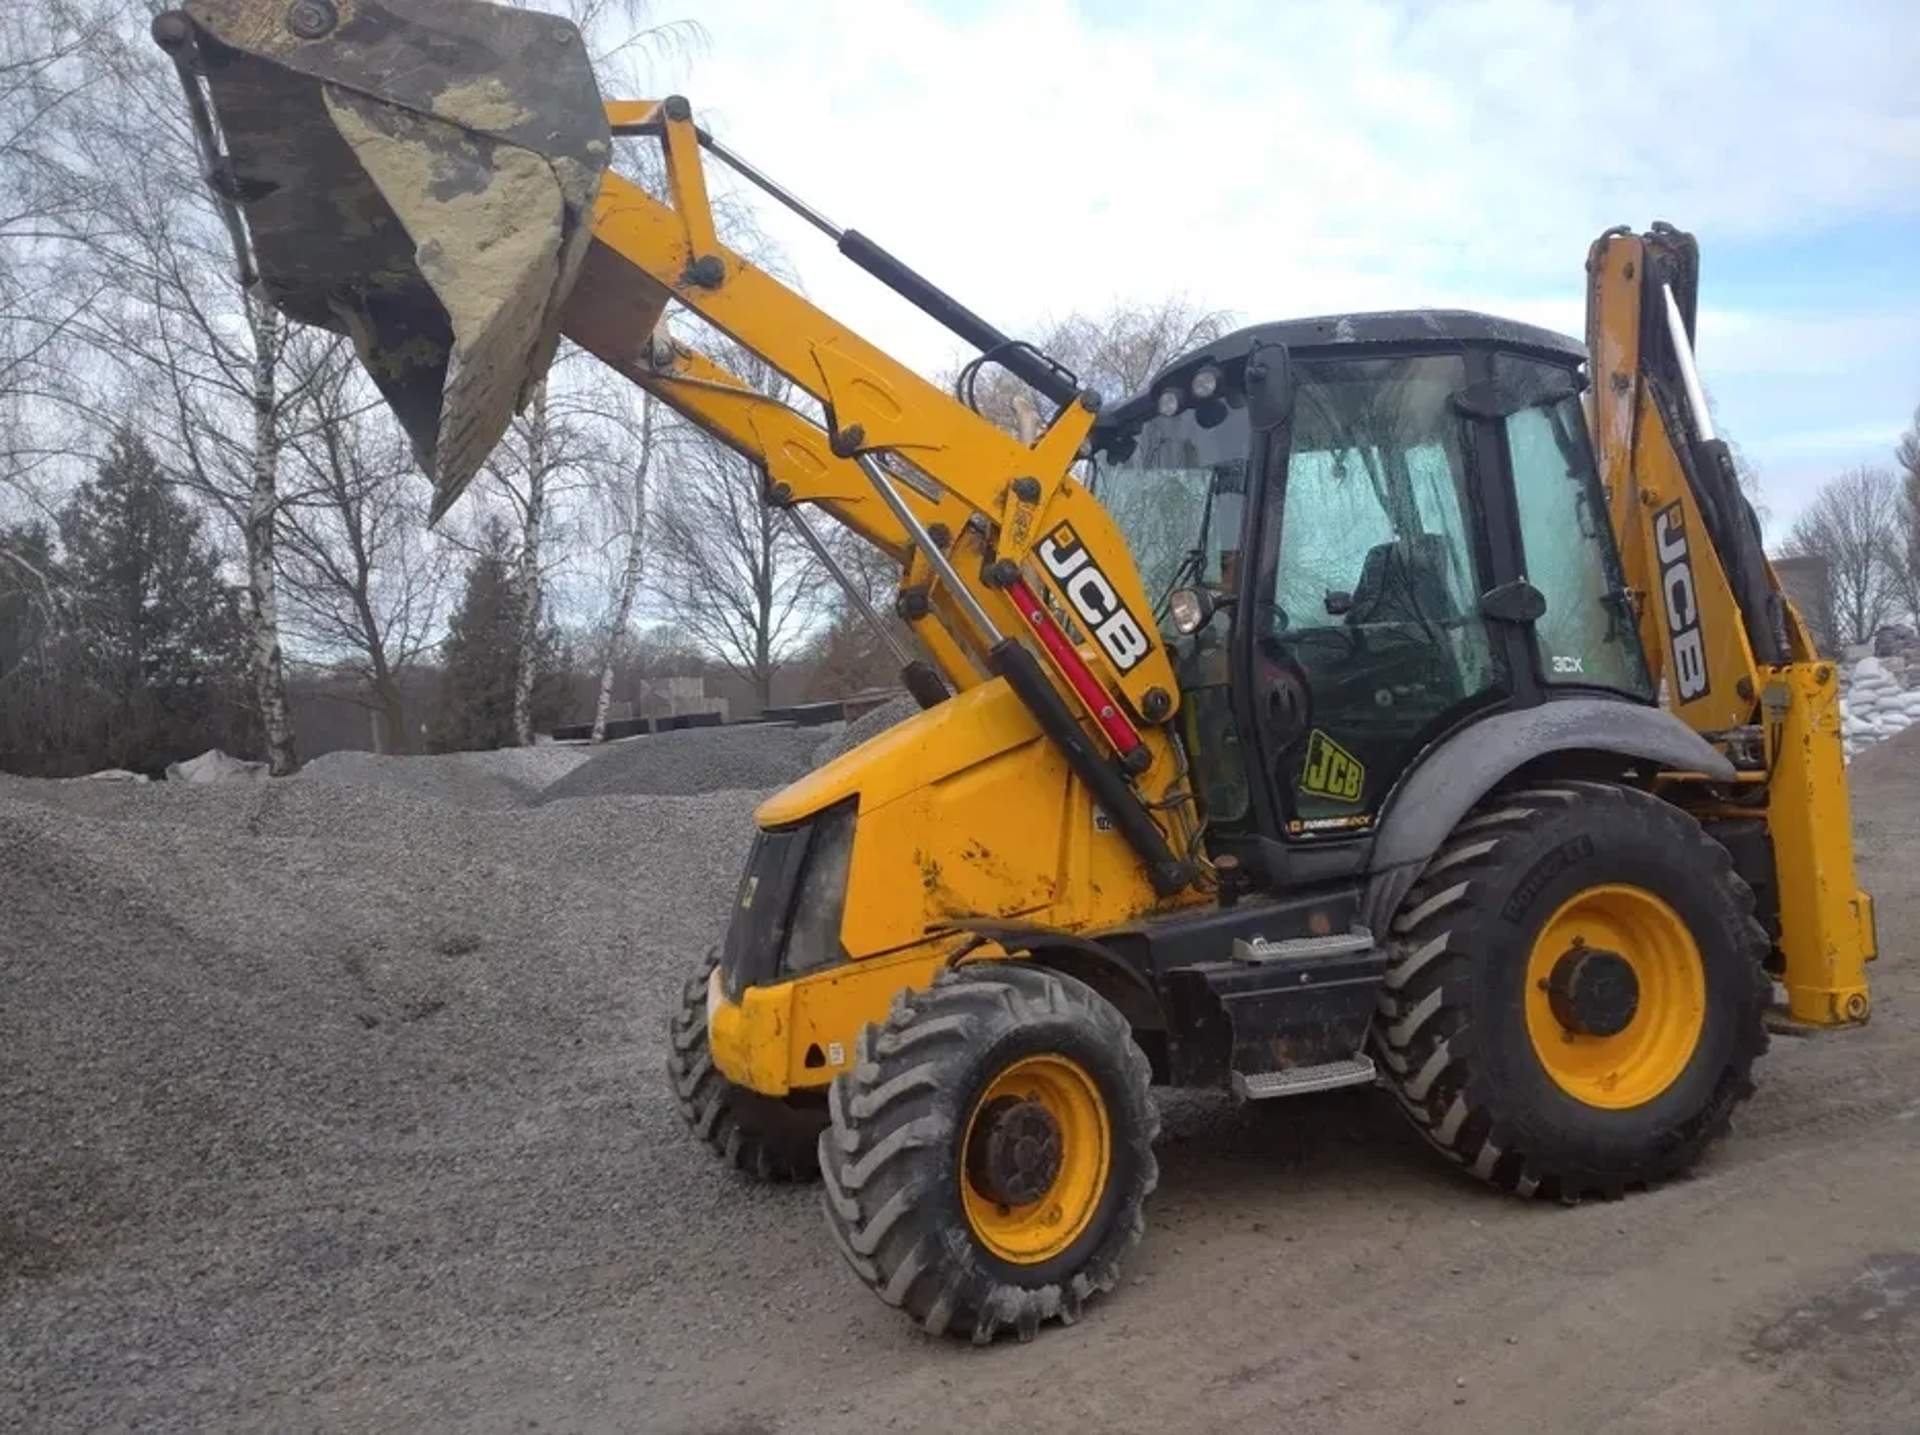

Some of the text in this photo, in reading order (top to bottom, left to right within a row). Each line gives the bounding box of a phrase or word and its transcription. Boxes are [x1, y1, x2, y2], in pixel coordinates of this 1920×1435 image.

[1039, 534, 1149, 670] JCB
[1656, 511, 1706, 699] JCB
[1307, 739, 1361, 798] JCB
